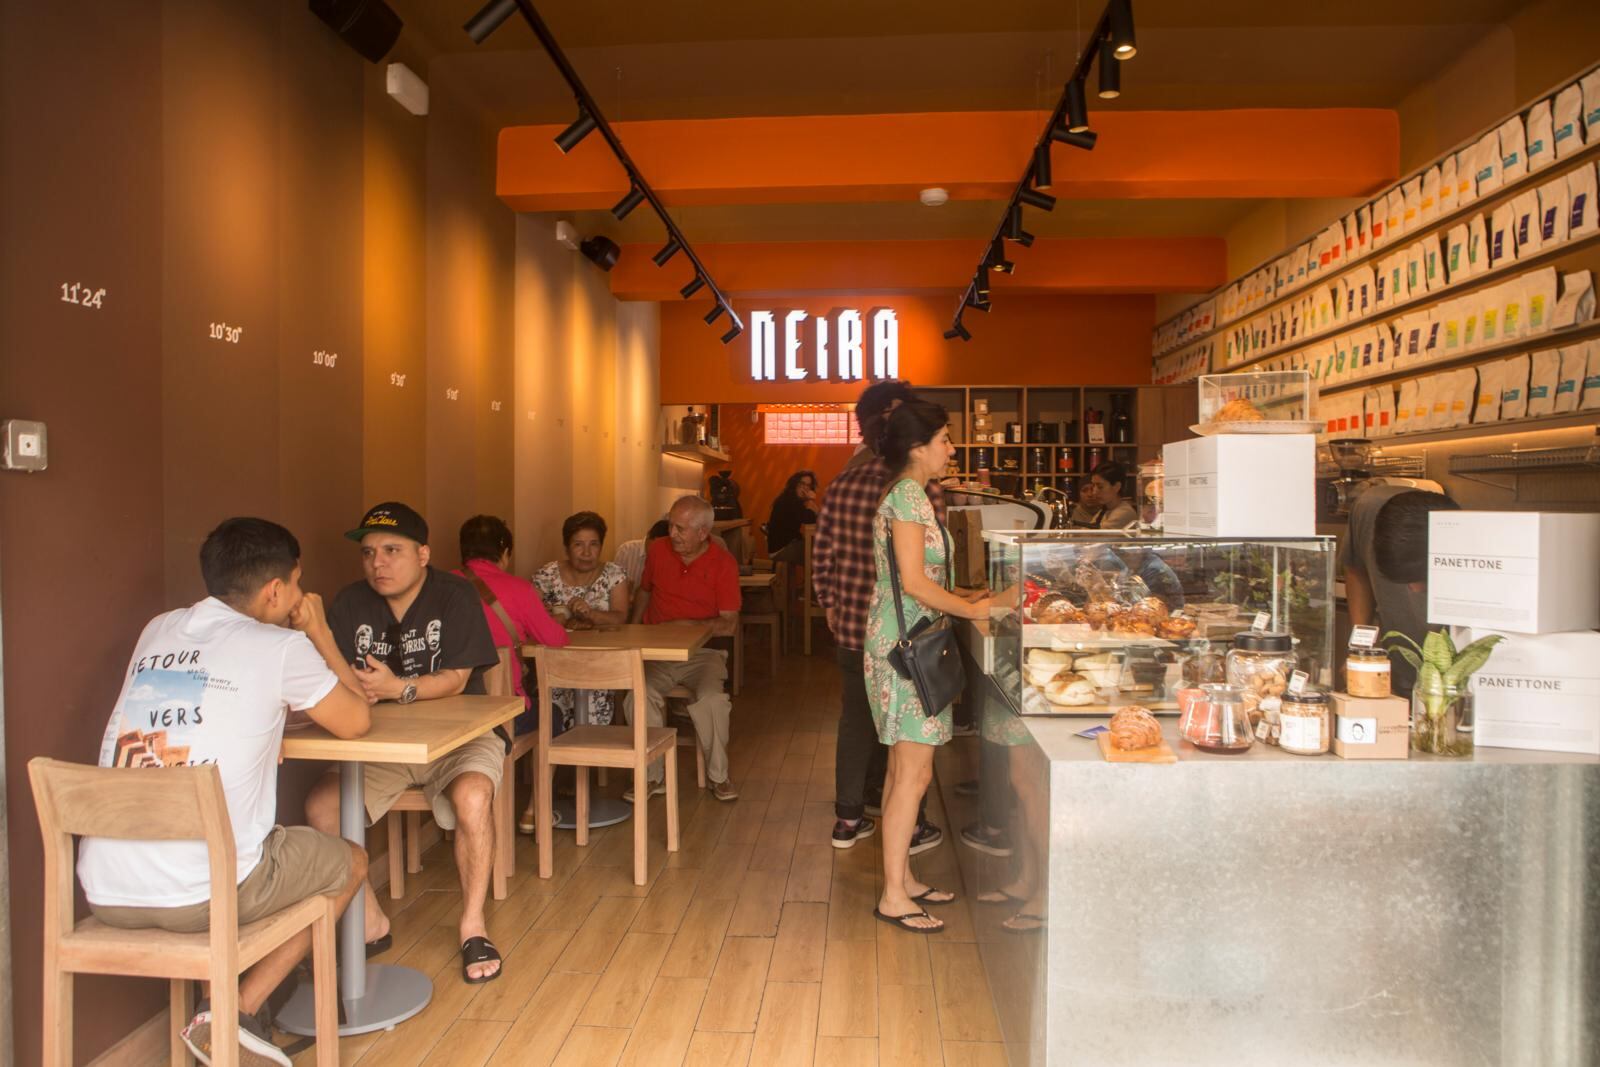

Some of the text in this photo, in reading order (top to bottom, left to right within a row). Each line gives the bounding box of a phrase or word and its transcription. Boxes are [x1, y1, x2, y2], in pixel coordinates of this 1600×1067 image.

[751, 309, 899, 380] NEIRA
[1434, 556, 1503, 570] PANETTONE
[1478, 676, 1562, 691] PANETTONE
[150, 706, 203, 728] VERS
